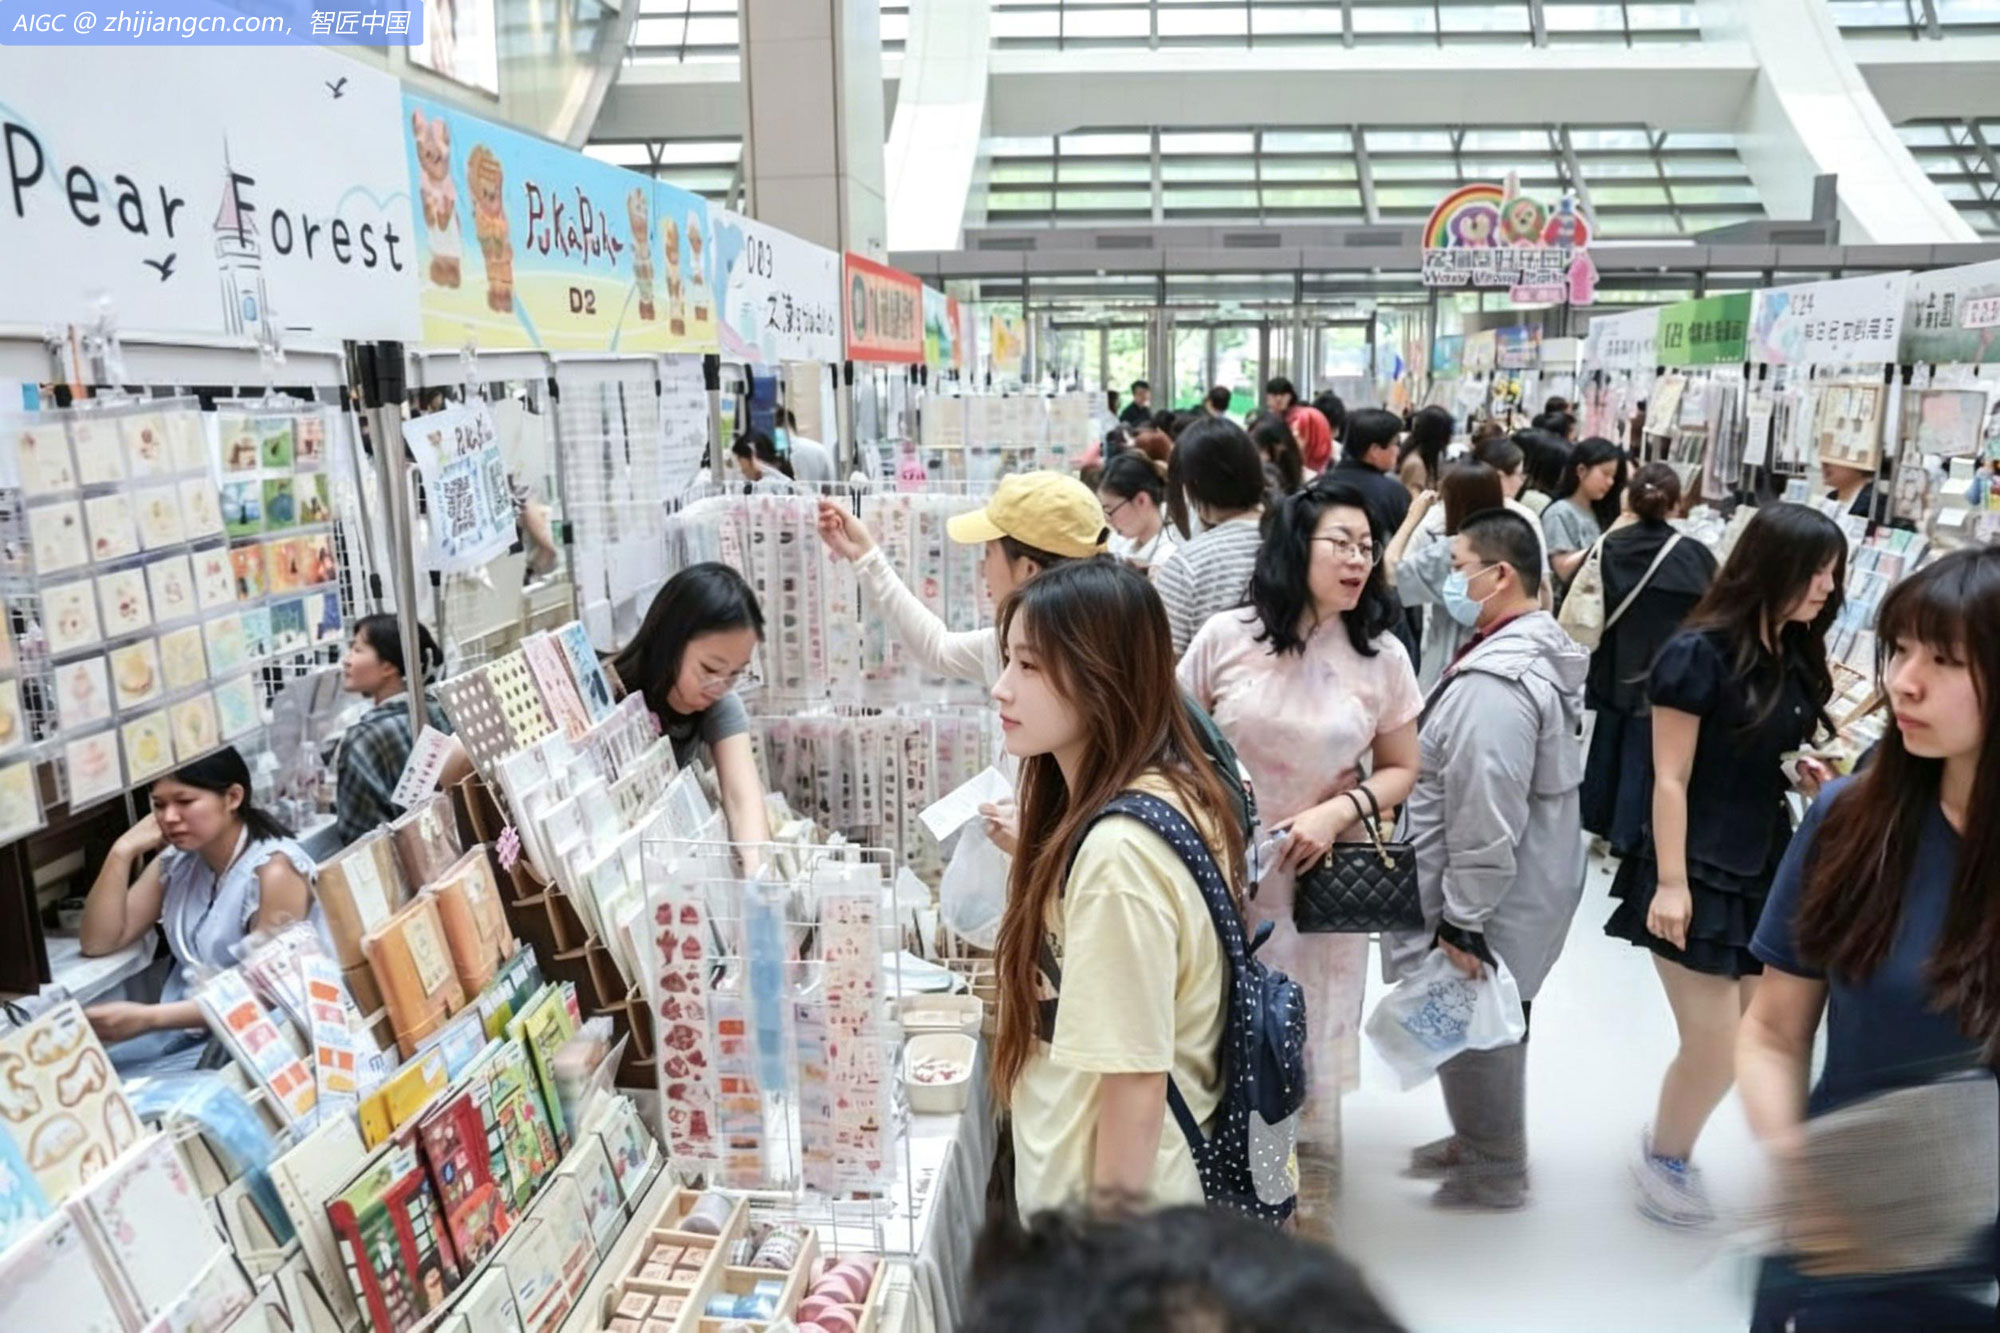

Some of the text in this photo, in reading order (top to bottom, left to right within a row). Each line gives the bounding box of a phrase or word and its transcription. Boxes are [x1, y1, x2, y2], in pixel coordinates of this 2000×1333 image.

[3, 122, 402, 271] Pear Forest
[569, 287, 596, 314] D2
